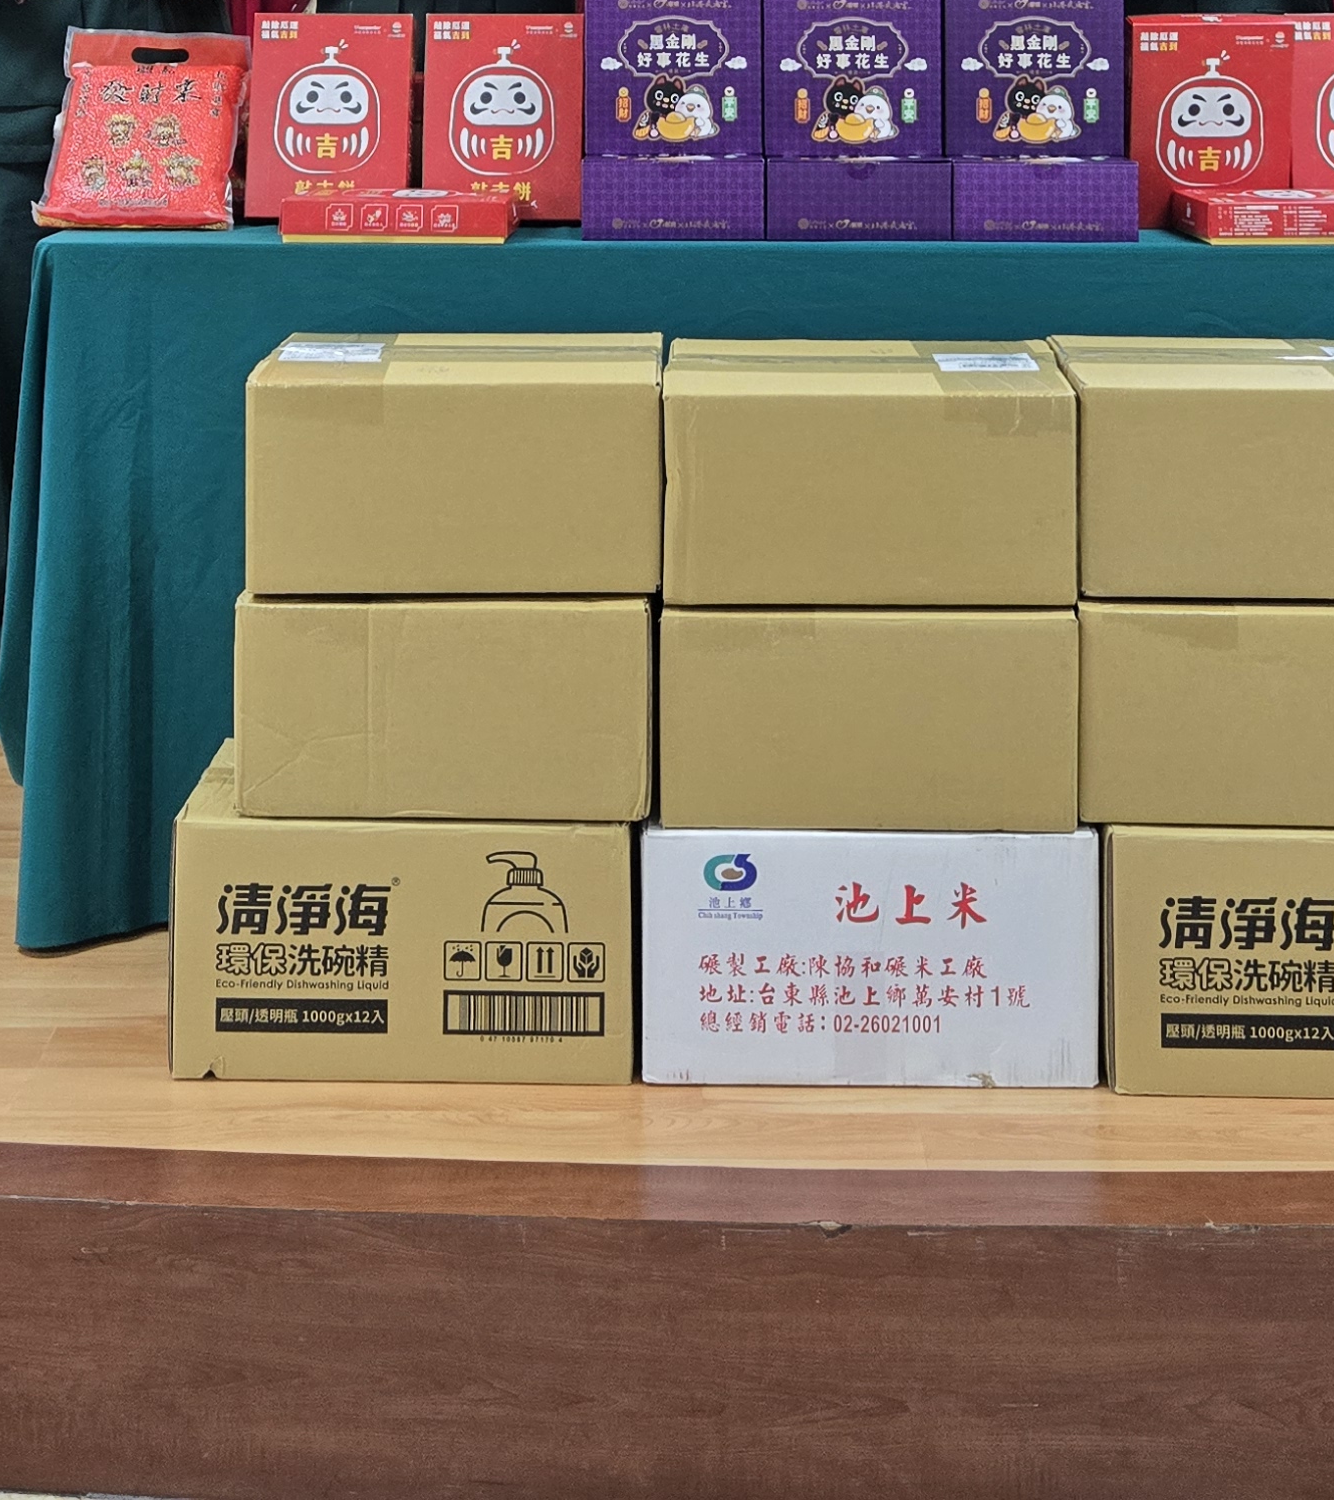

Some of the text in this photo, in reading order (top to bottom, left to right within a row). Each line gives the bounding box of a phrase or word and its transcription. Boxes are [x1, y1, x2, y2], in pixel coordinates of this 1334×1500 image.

[637, 51, 710, 68] 好事花生
[816, 53, 890, 69] 好事花生
[998, 53, 1072, 69] 好事花生
[315, 132, 339, 159] 吉
[490, 134, 514, 161] 吉
[1198, 146, 1222, 172] 吉
[216, 883, 392, 936] 清淨海
[708, 896, 752, 909] 池上鄉
[835, 882, 988, 930] 池上米
[734, 911, 763, 921] Township
[216, 943, 390, 977] 環保洗碗精
[216, 979, 389, 991] Eco-Friendly Dishwashing Liquid
[698, 984, 1031, 1008] 地址:台東縣池上鄉萬安村1號
[1160, 994, 1229, 1007] Eco-Friendly
[1232, 994, 1302, 1007] Dishwashing
[302, 1008, 385, 1026] 1000gx12入
[1250, 1025, 1334, 1043] 1000gx12入
